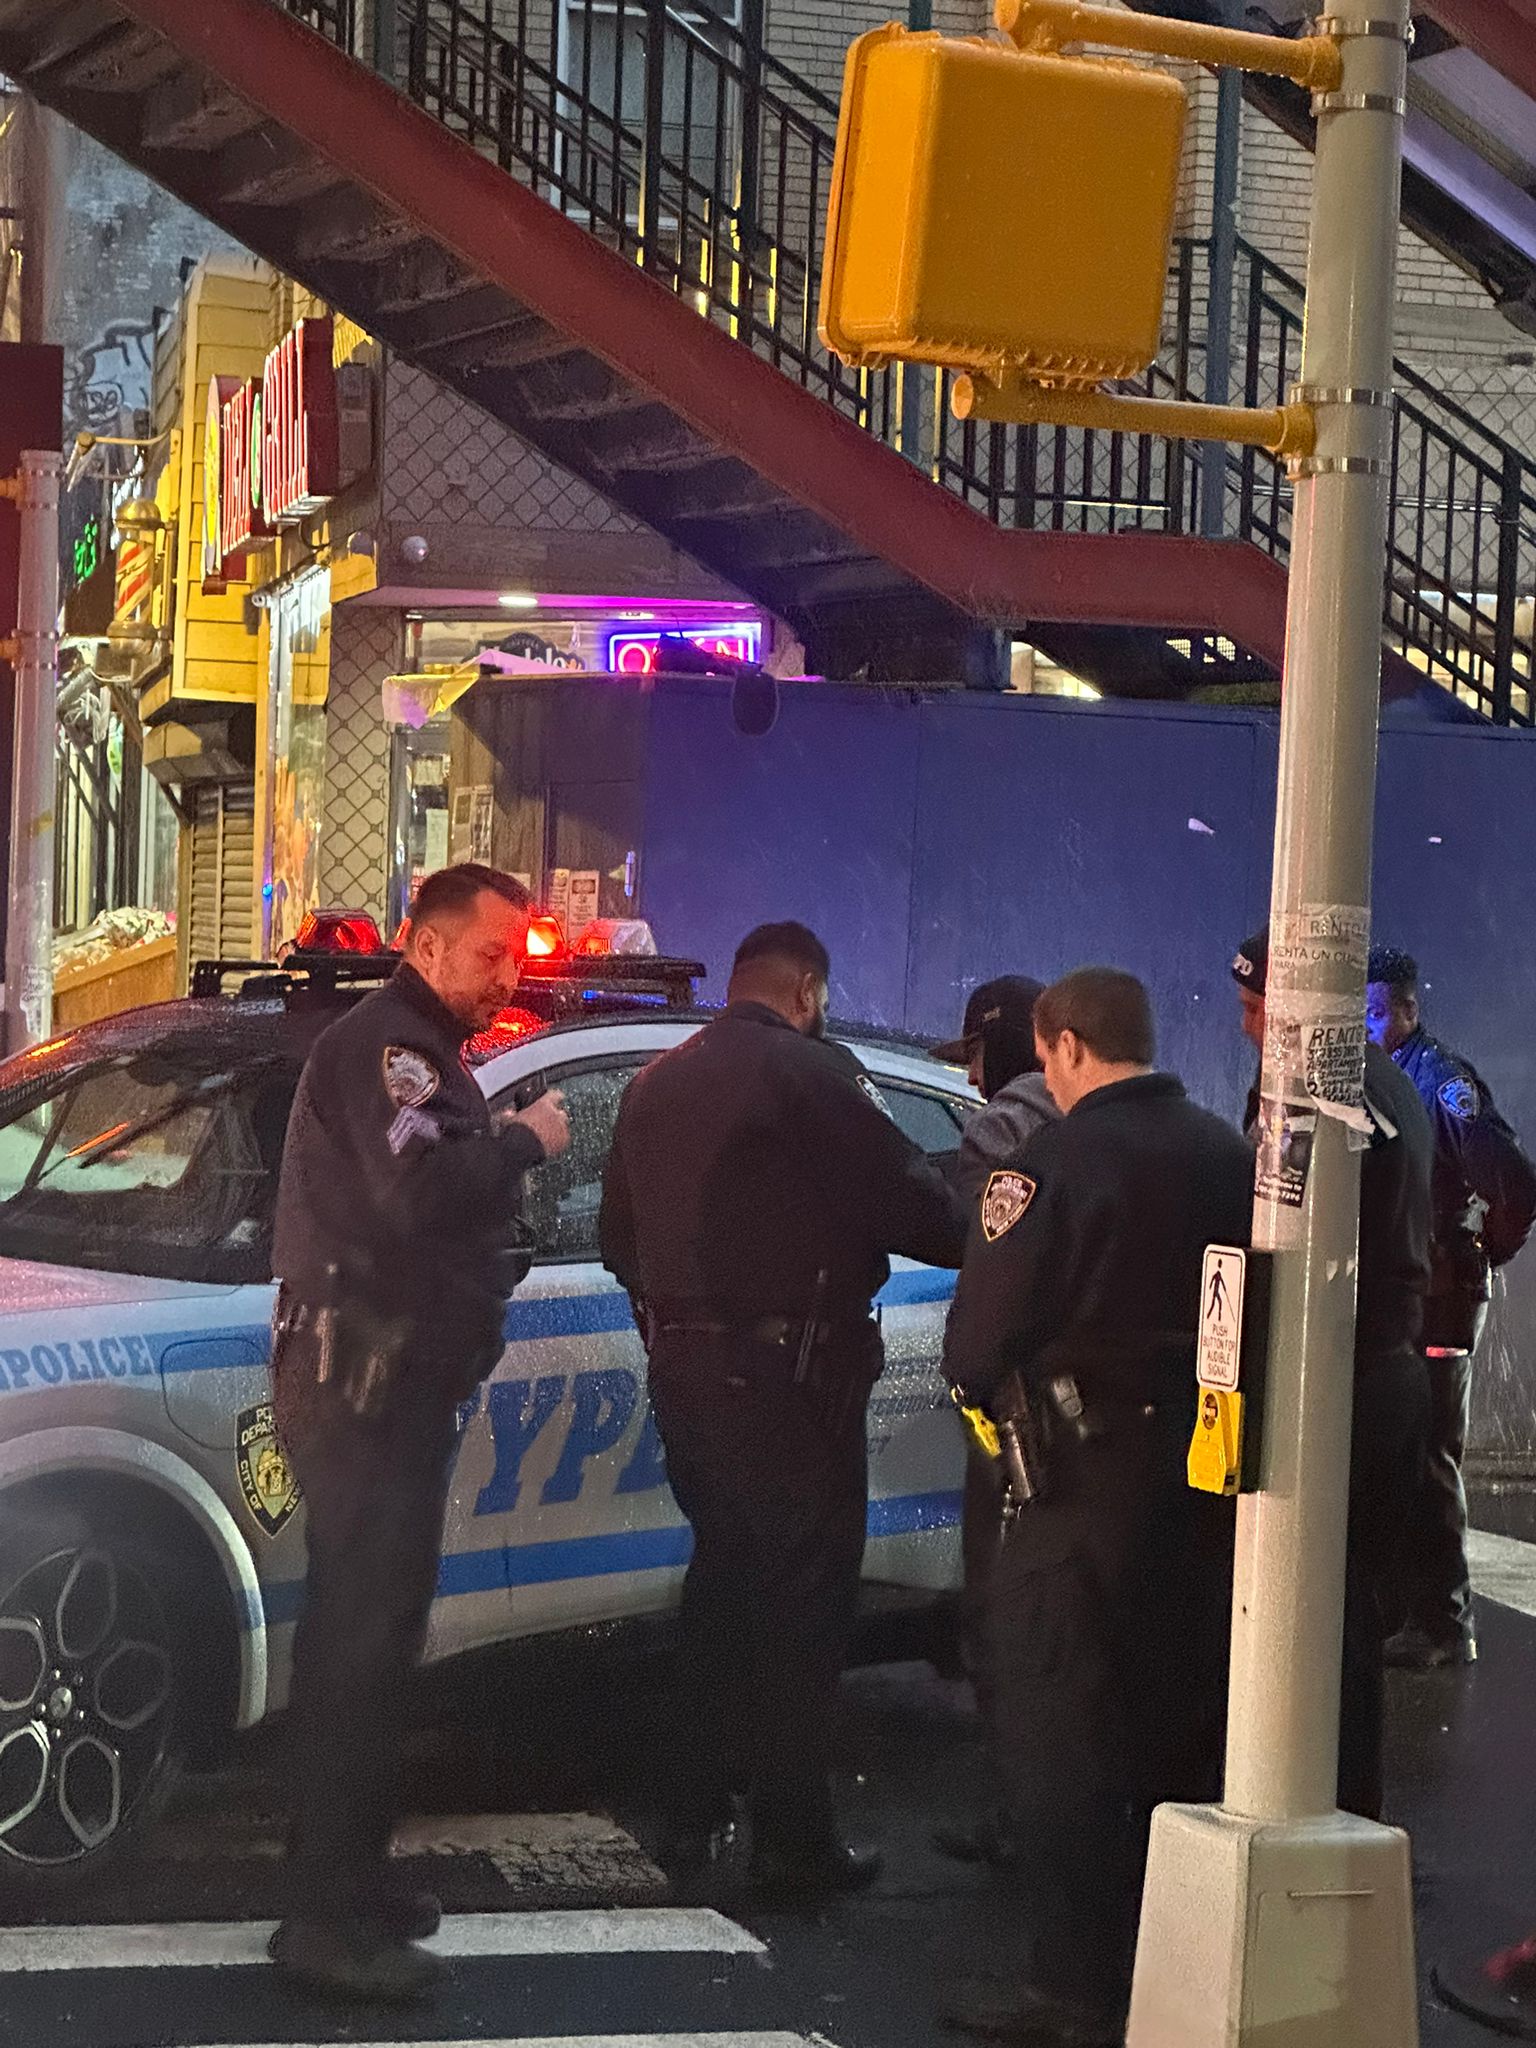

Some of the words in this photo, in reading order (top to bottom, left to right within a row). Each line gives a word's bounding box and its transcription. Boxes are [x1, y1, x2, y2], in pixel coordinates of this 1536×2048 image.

[222, 376, 252, 556] DELI
[262, 317, 309, 527] GRILL
[1212, 1323, 1228, 1336] PUSH
[1203, 1336, 1224, 1349] BUTTON
[1225, 1340, 1235, 1351] FOR
[1, 1335, 153, 1389] POLICE
[1207, 1351, 1231, 1366] AUDIBLE
[1208, 1364, 1228, 1378] SIGNAL
[240, 1460, 254, 1492] CITY
[249, 1494, 263, 1512] OF
